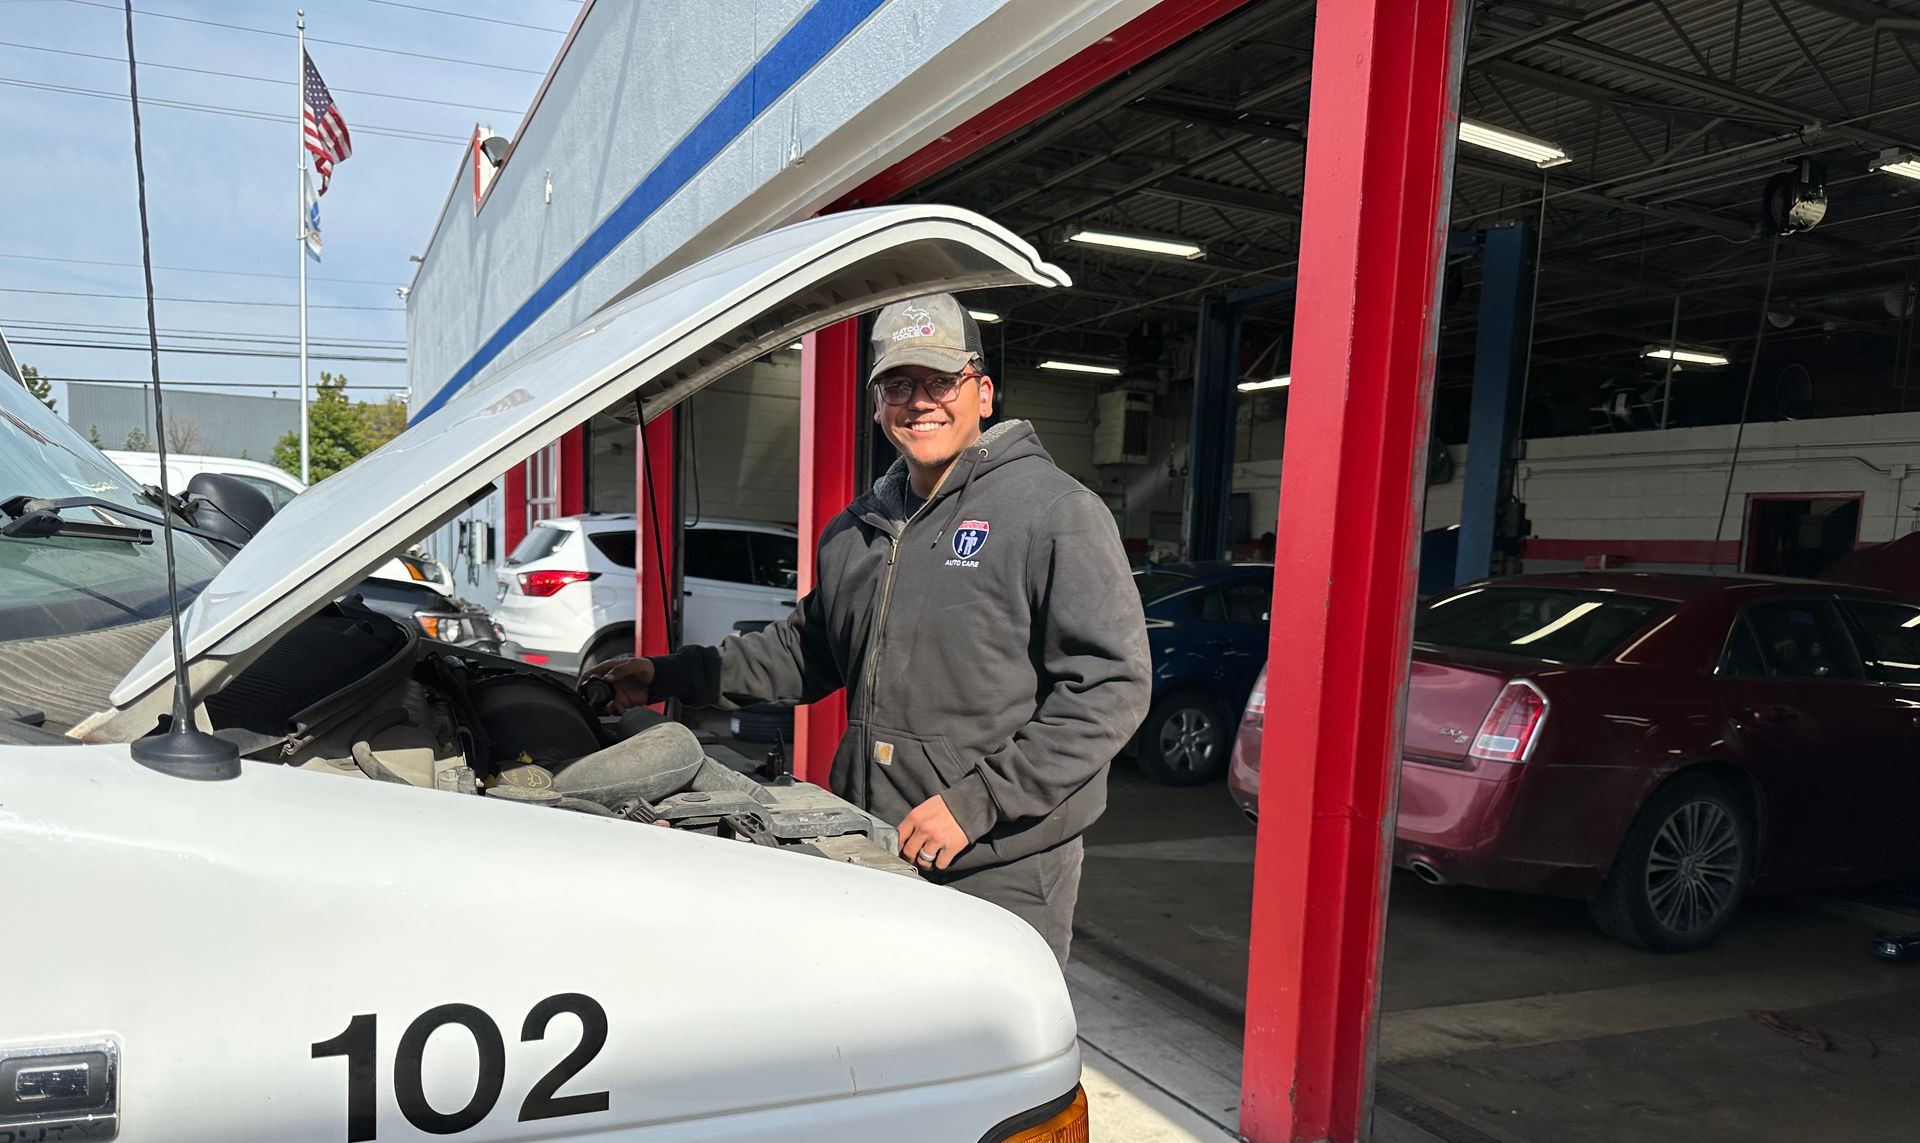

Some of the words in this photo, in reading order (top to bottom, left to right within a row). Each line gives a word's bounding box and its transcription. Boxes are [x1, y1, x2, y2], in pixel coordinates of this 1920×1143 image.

[892, 325, 919, 337] MATCO
[892, 332, 920, 342] TOOLS
[311, 992, 610, 1142] 102
